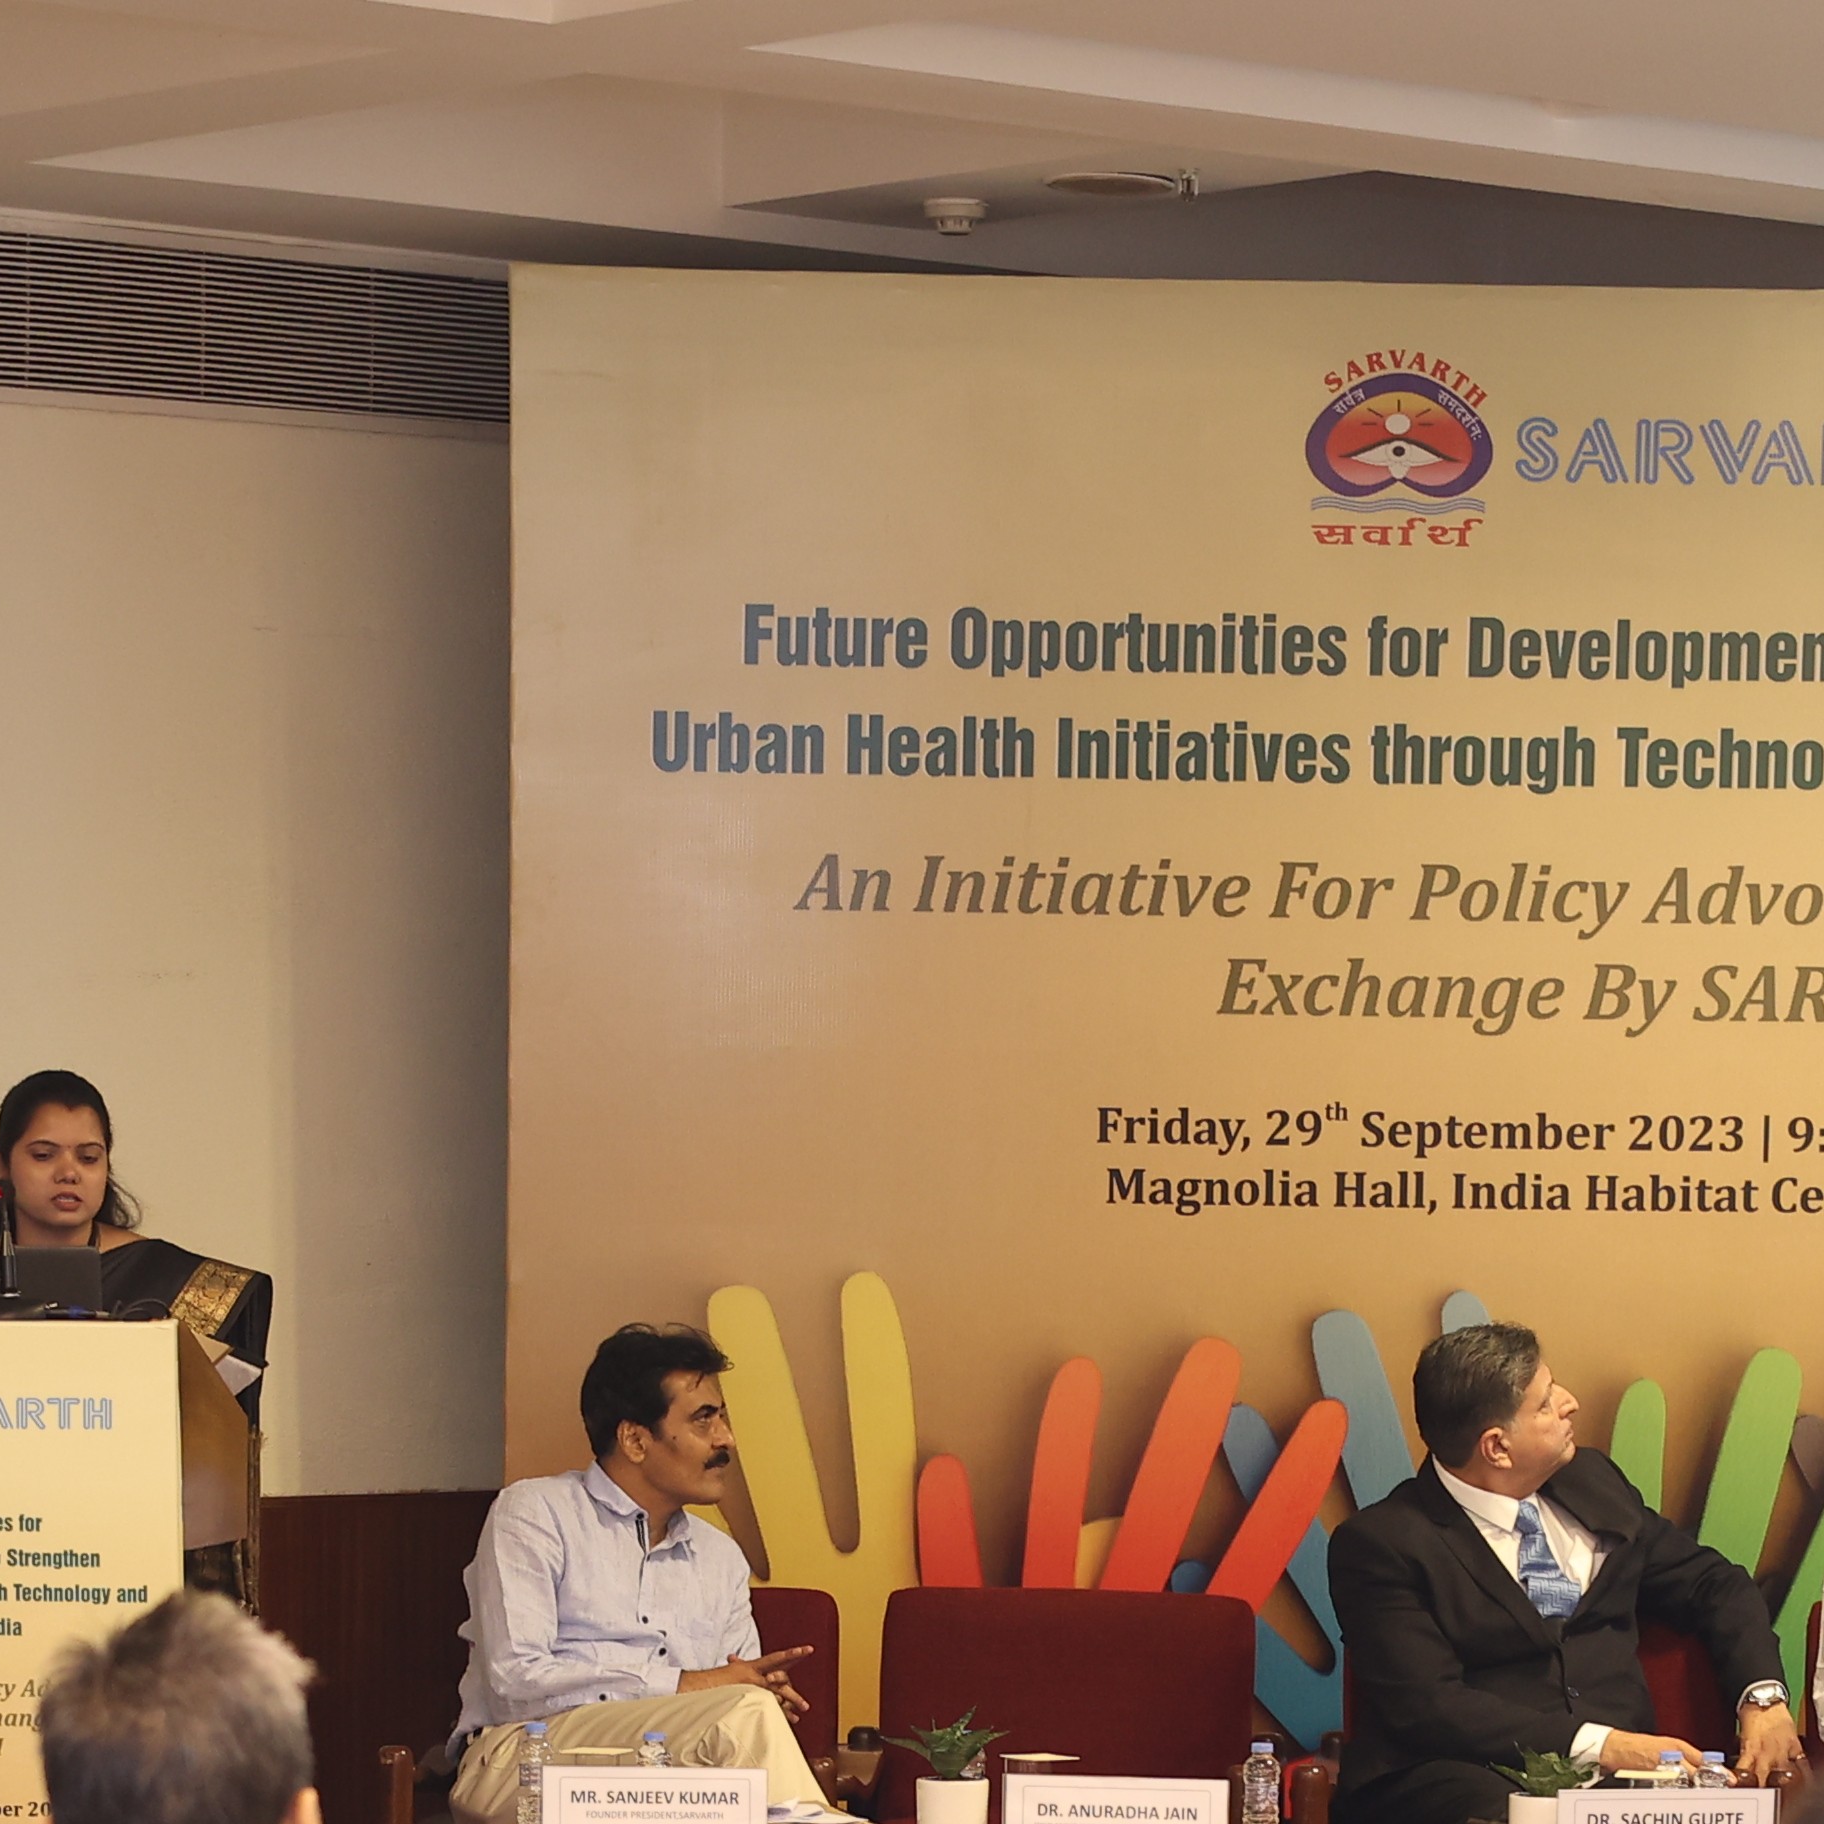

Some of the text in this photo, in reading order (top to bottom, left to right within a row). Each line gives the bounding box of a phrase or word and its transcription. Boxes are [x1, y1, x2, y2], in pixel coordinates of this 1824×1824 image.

[1324, 349, 1488, 408] SARVARTH
[744, 604, 927, 668] Future
[951, 607, 1346, 678] Opportunities
[1368, 616, 1448, 677] for
[653, 711, 824, 774] Urban
[847, 714, 1034, 778] Health
[1058, 718, 1350, 784] Initiatives
[1371, 724, 1595, 794] through
[793, 854, 891, 911] An
[913, 856, 1250, 917] Initiative
[1269, 862, 1394, 919] For
[1409, 863, 1630, 940] Policy
[1216, 958, 1564, 1036] Exchange
[1583, 964, 1677, 1038] By
[1097, 1107, 1250, 1155] Friday,
[1266, 1102, 1347, 1146] 29th
[1361, 1112, 1615, 1158] September
[1629, 1115, 1743, 1152] 2023
[1106, 1168, 1319, 1216] Magnolia
[1334, 1171, 1436, 1215] Hall,
[1452, 1173, 1571, 1210] India
[1586, 1175, 1759, 1212] Habitat
[19, 1514, 42, 1532] for
[7, 1549, 100, 1569] Strengthen
[13, 1584, 110, 1605] Technology
[117, 1585, 147, 1603] and
[28, 1799, 52, 1818] 20
[571, 1790, 739, 1805] MR. SANJEEV KUMAR
[1038, 1804, 1198, 1821] DR. ANURADHA JAIN
[586, 1811, 627, 1819] FOUNDER
